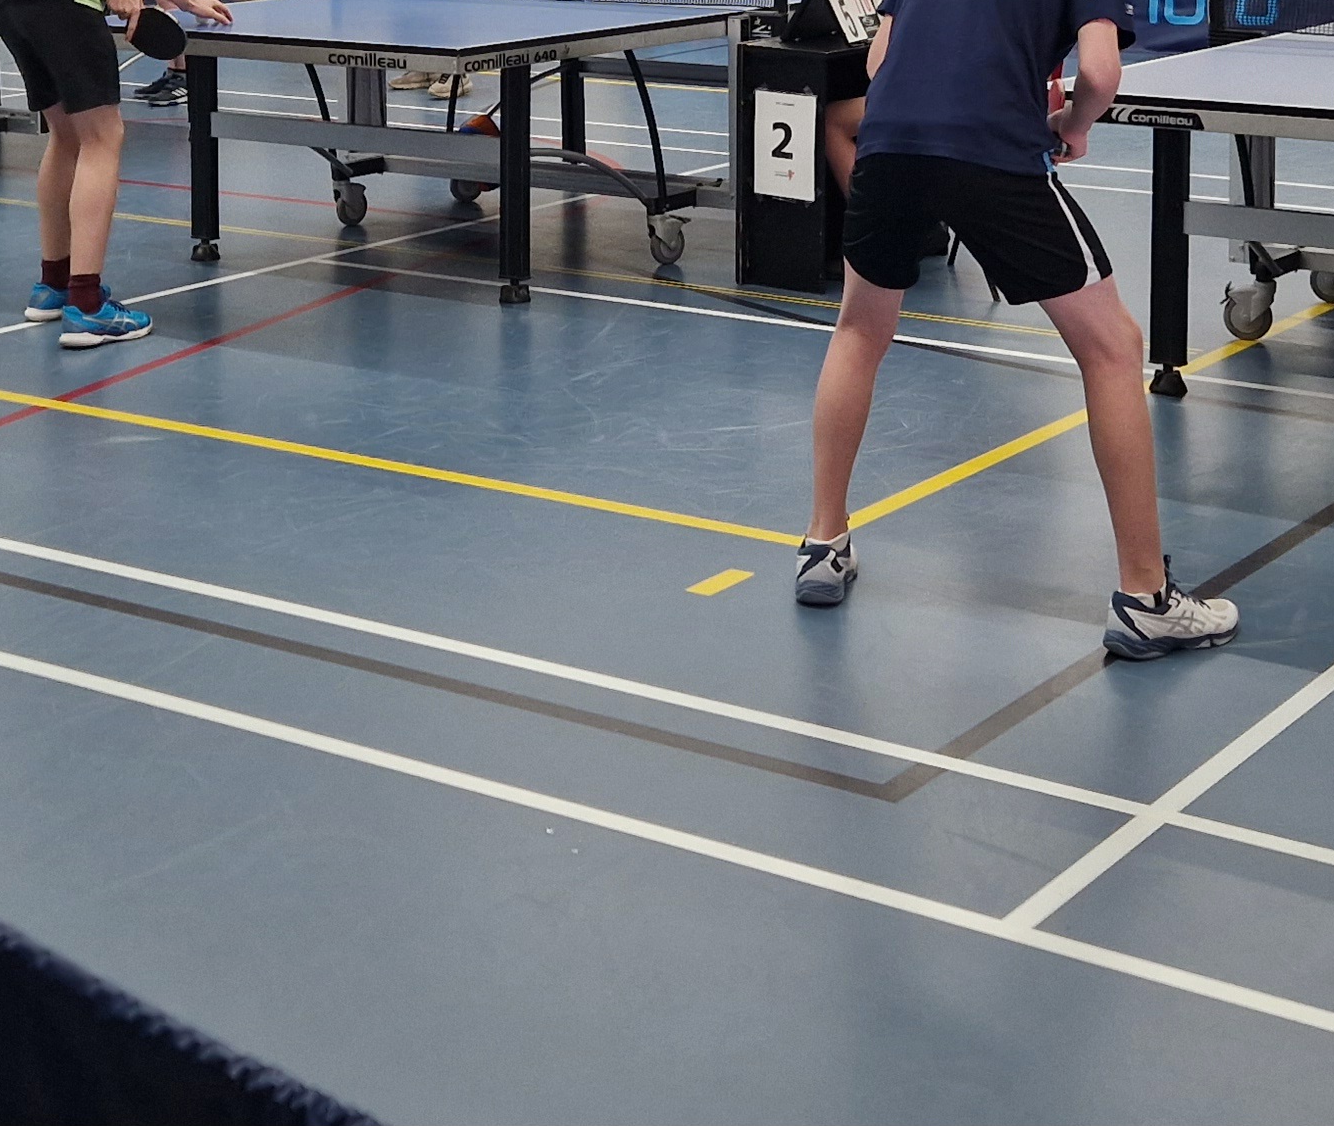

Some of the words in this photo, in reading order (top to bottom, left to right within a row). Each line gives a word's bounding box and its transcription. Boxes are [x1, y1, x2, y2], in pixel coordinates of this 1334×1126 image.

[837, 0, 860, 39] 5
[328, 52, 408, 70] cornilleau
[464, 52, 531, 73] cornilleau
[534, 49, 558, 63] 640
[1131, 111, 1194, 127] cornilleau
[771, 122, 794, 160] 2
